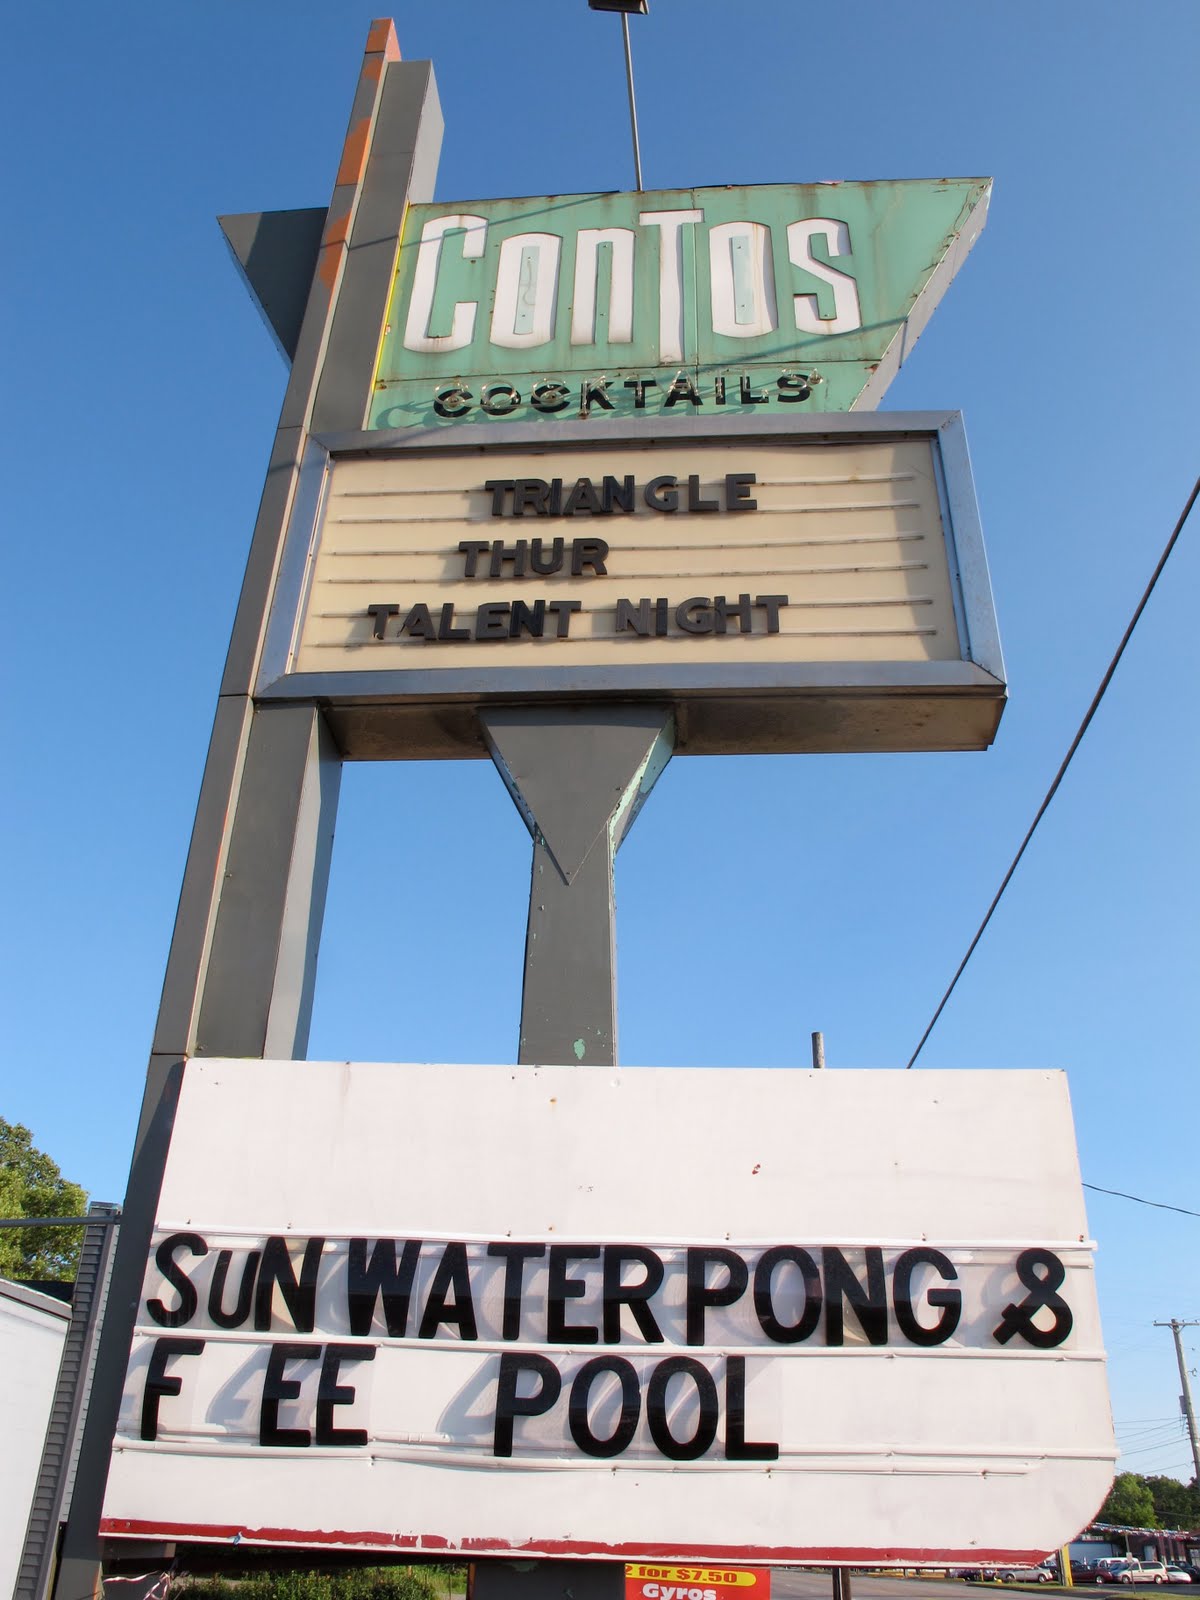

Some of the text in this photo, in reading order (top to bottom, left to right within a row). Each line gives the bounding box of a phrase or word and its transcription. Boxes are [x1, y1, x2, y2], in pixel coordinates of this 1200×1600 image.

[433, 370, 816, 418] COCKTAILS
[485, 473, 757, 517] TRIANGLE
[458, 537, 609, 578] THUR
[368, 594, 789, 641] TALENT NIGHT
[992, 1247, 1074, 1349] &
[494, 1352, 780, 1461] POOL
[638, 1566, 671, 1578] for
[676, 1568, 738, 1583] $7.50
[642, 1583, 717, 1600] Gyros
